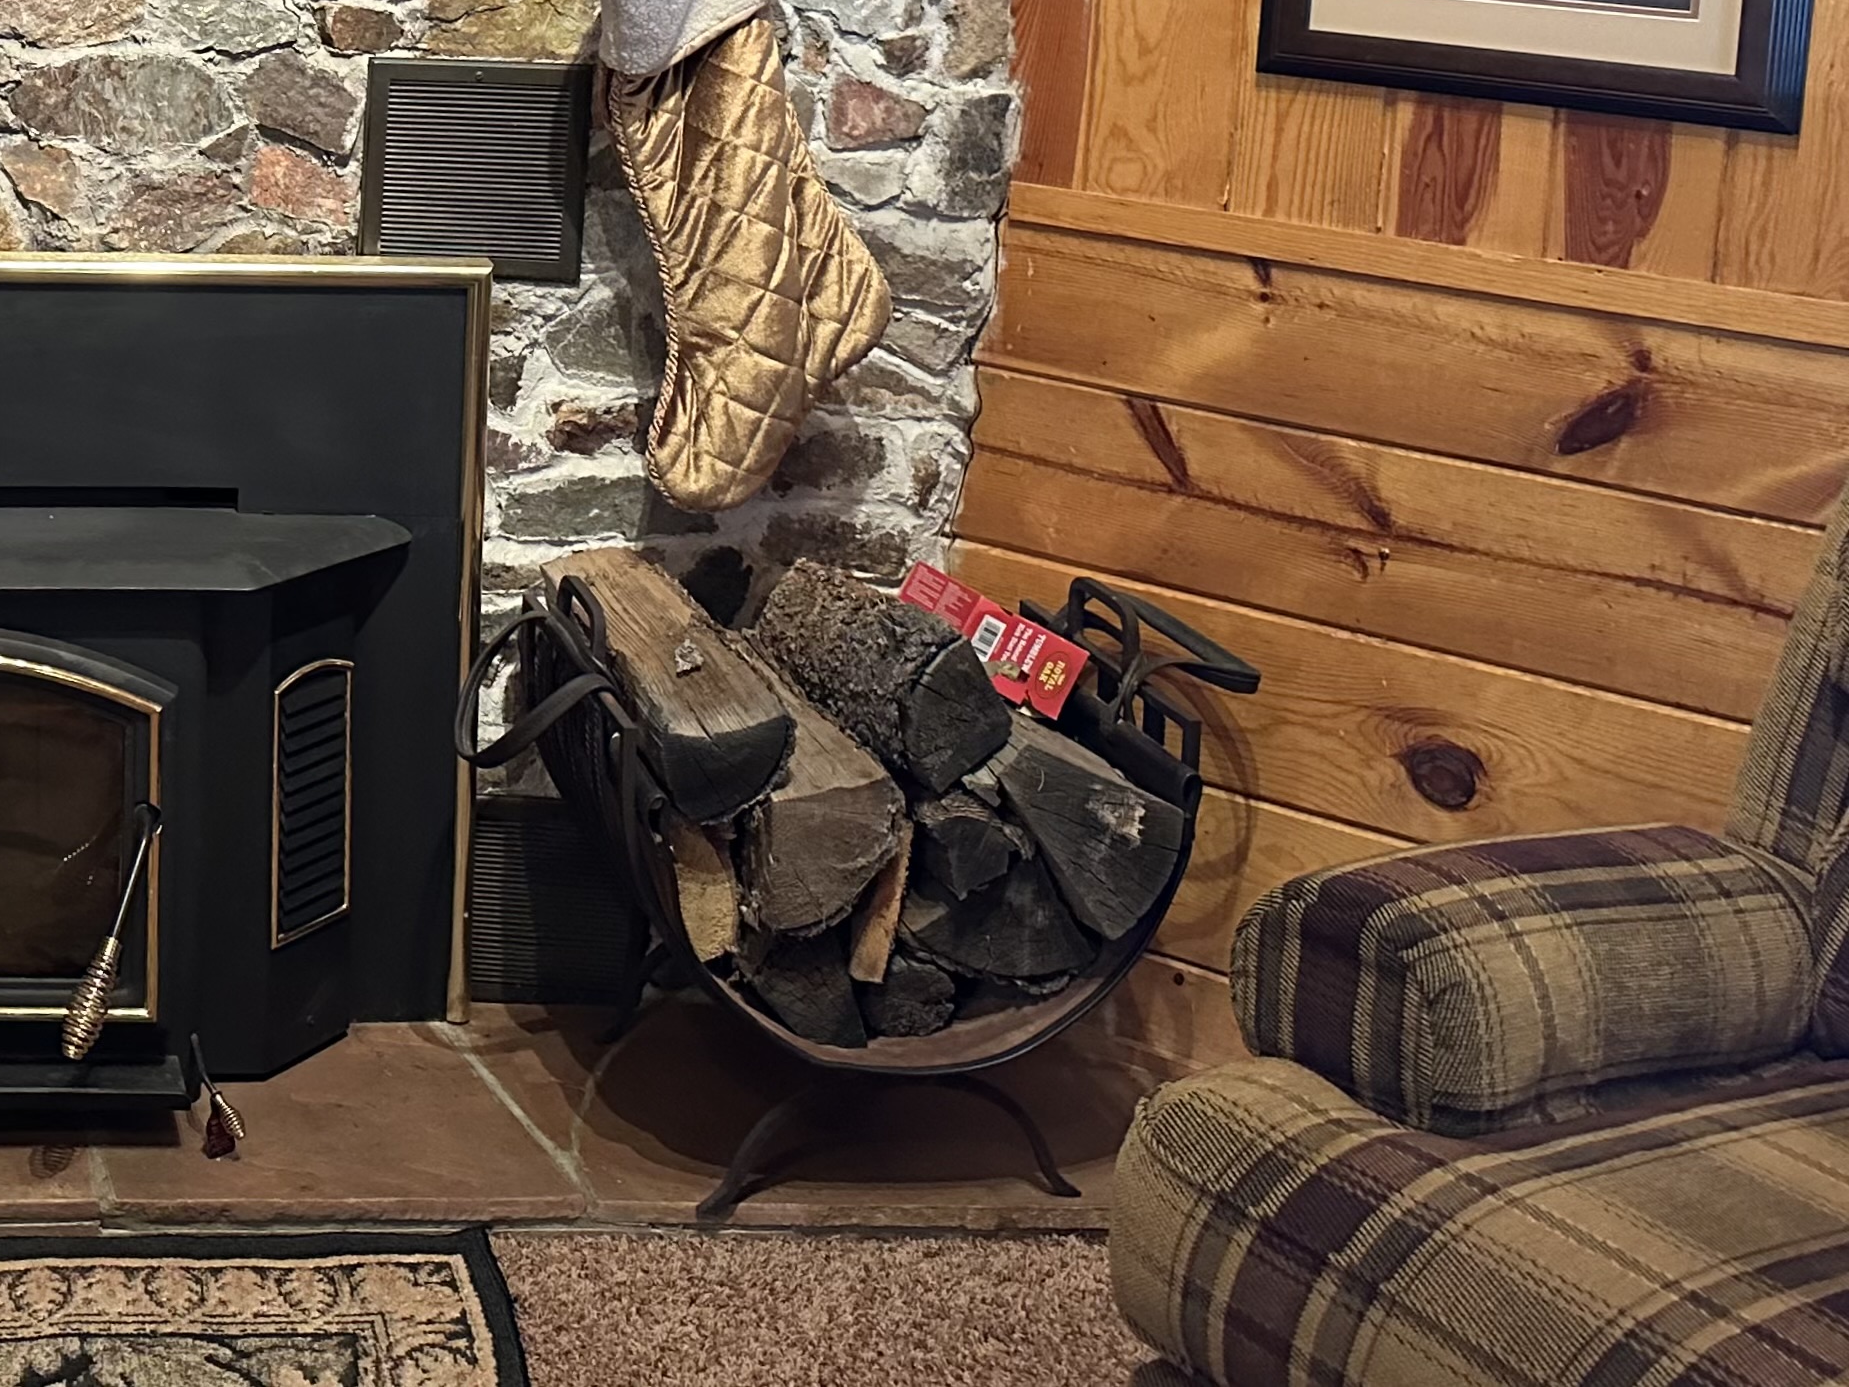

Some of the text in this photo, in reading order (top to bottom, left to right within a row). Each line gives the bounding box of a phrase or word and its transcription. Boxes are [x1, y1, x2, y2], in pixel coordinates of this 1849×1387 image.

[1021, 634, 1046, 674] TUMBLEW
[1039, 662, 1054, 682] OAK
[1044, 660, 1066, 691] ROYAL
